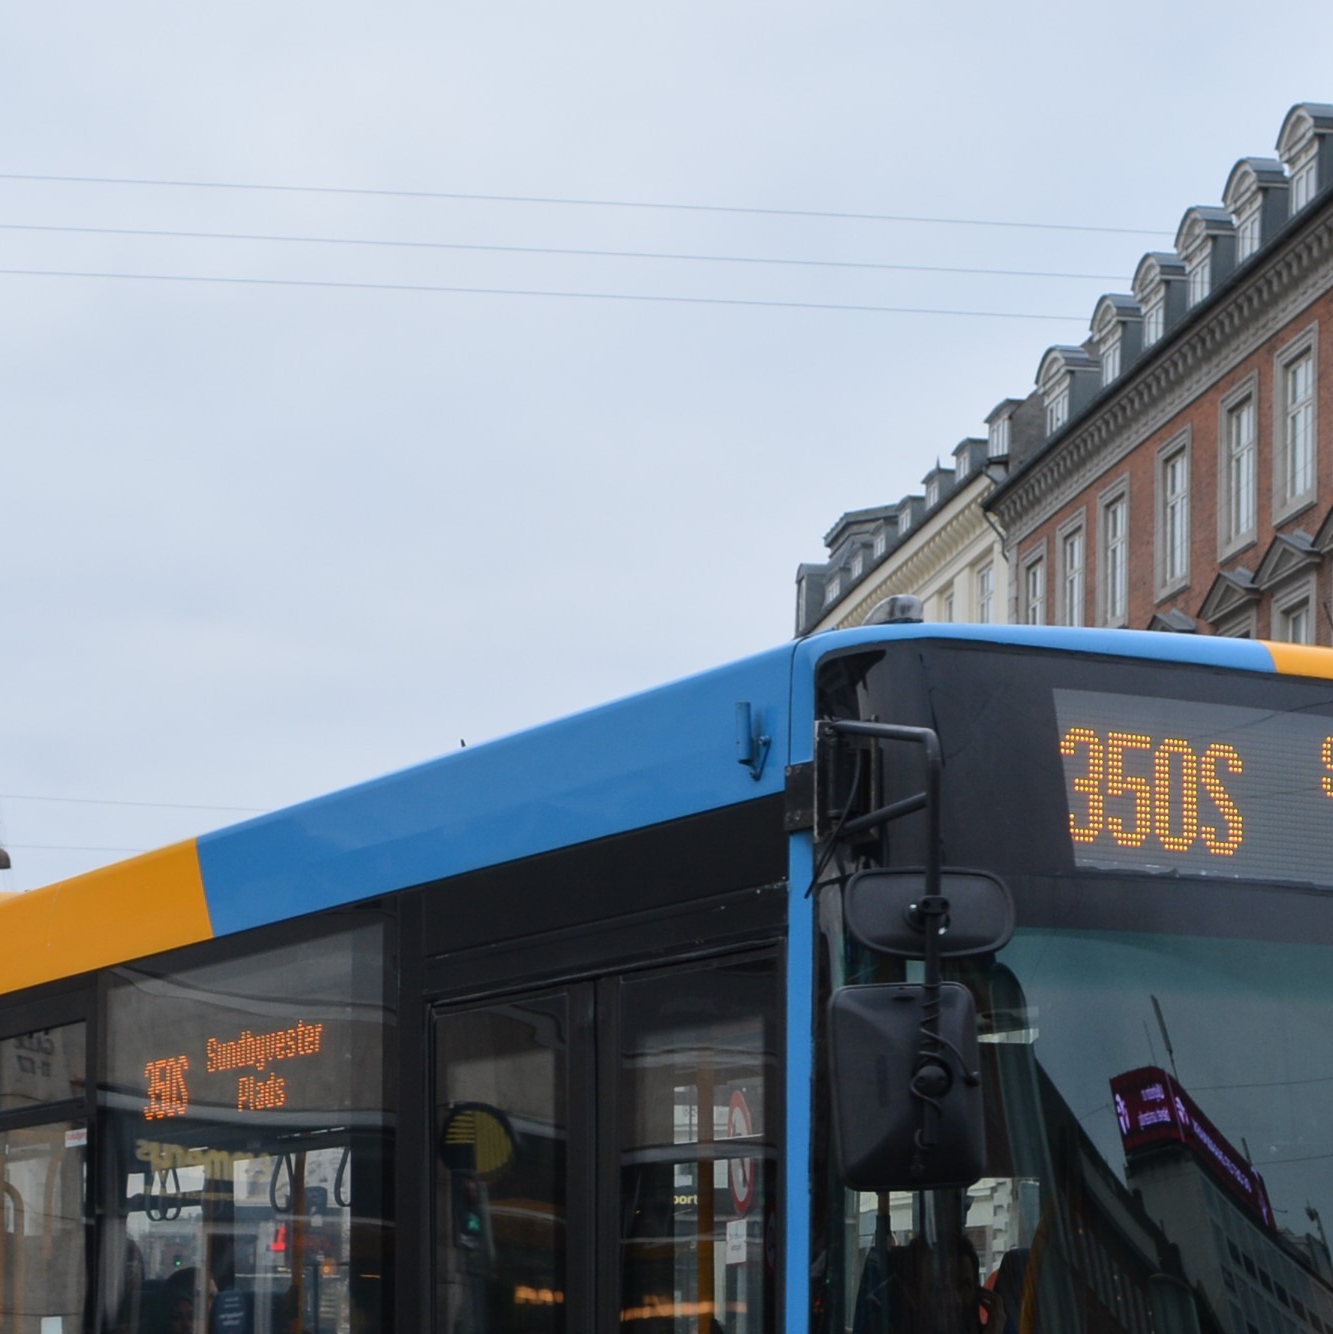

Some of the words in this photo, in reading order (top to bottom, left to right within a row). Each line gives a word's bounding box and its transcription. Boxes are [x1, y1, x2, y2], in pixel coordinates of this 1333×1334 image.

[1060, 727, 1244, 857] 350S
[206, 1019, 323, 1073] Sundbyvester
[237, 1072, 286, 1113] Plads
